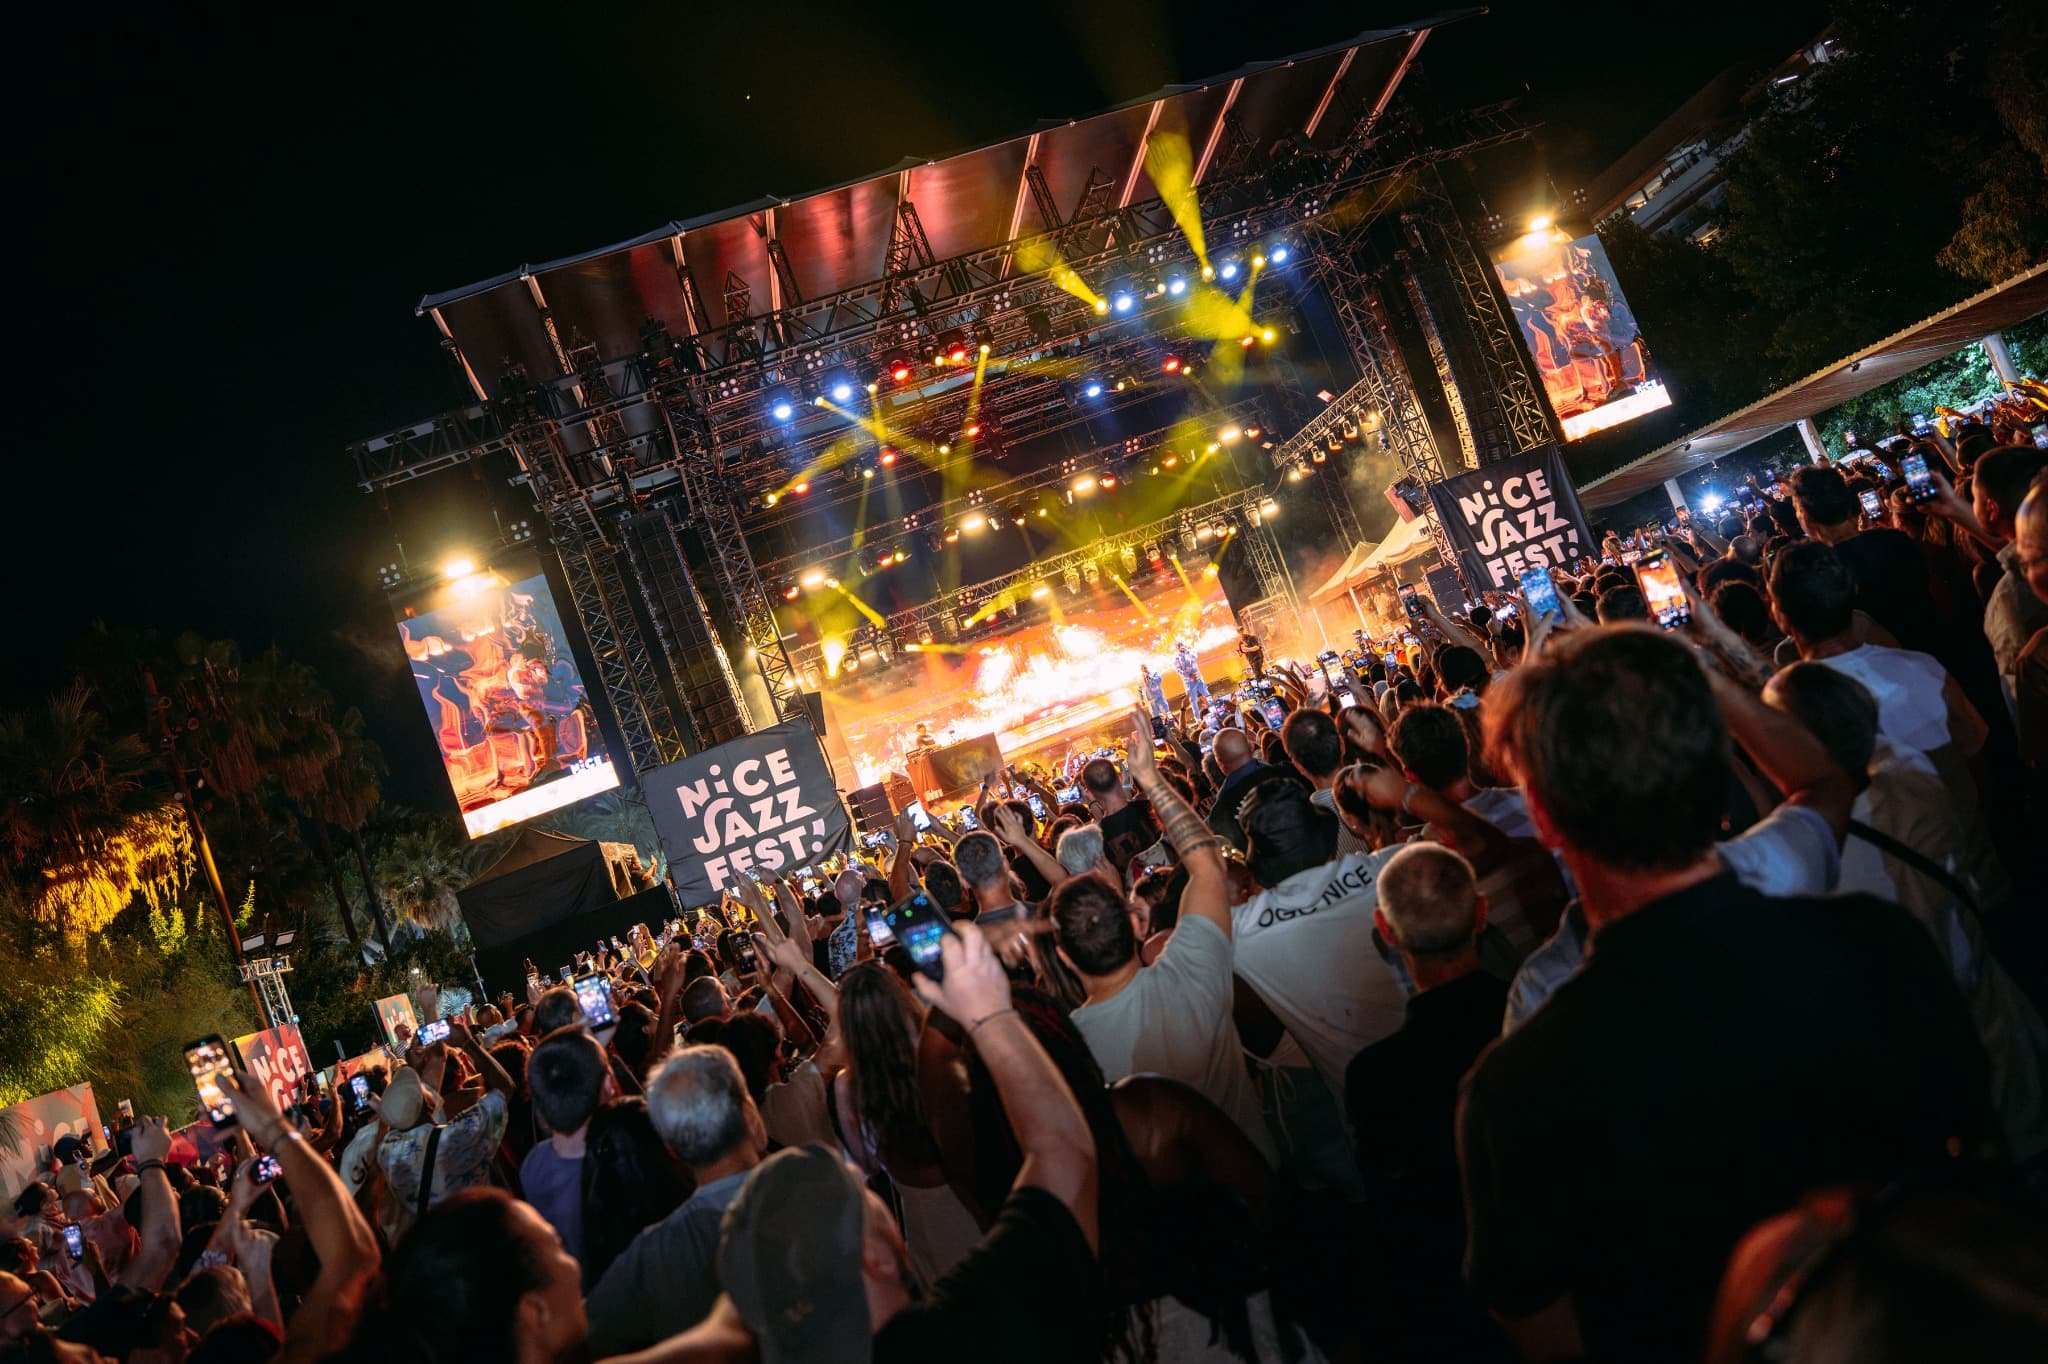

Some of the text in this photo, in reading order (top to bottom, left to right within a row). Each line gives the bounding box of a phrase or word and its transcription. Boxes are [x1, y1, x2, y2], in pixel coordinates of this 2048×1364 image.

[1459, 468, 1551, 526] NiCE
[1475, 501, 1571, 555] JAZZ
[1486, 528, 1579, 588] FEST!
[676, 749, 796, 819] NiCE
[693, 786, 817, 854] JAZZ
[703, 818, 826, 892] FEST!
[1321, 864, 1373, 906] NICE
[252, 1045, 306, 1090] NiCE
